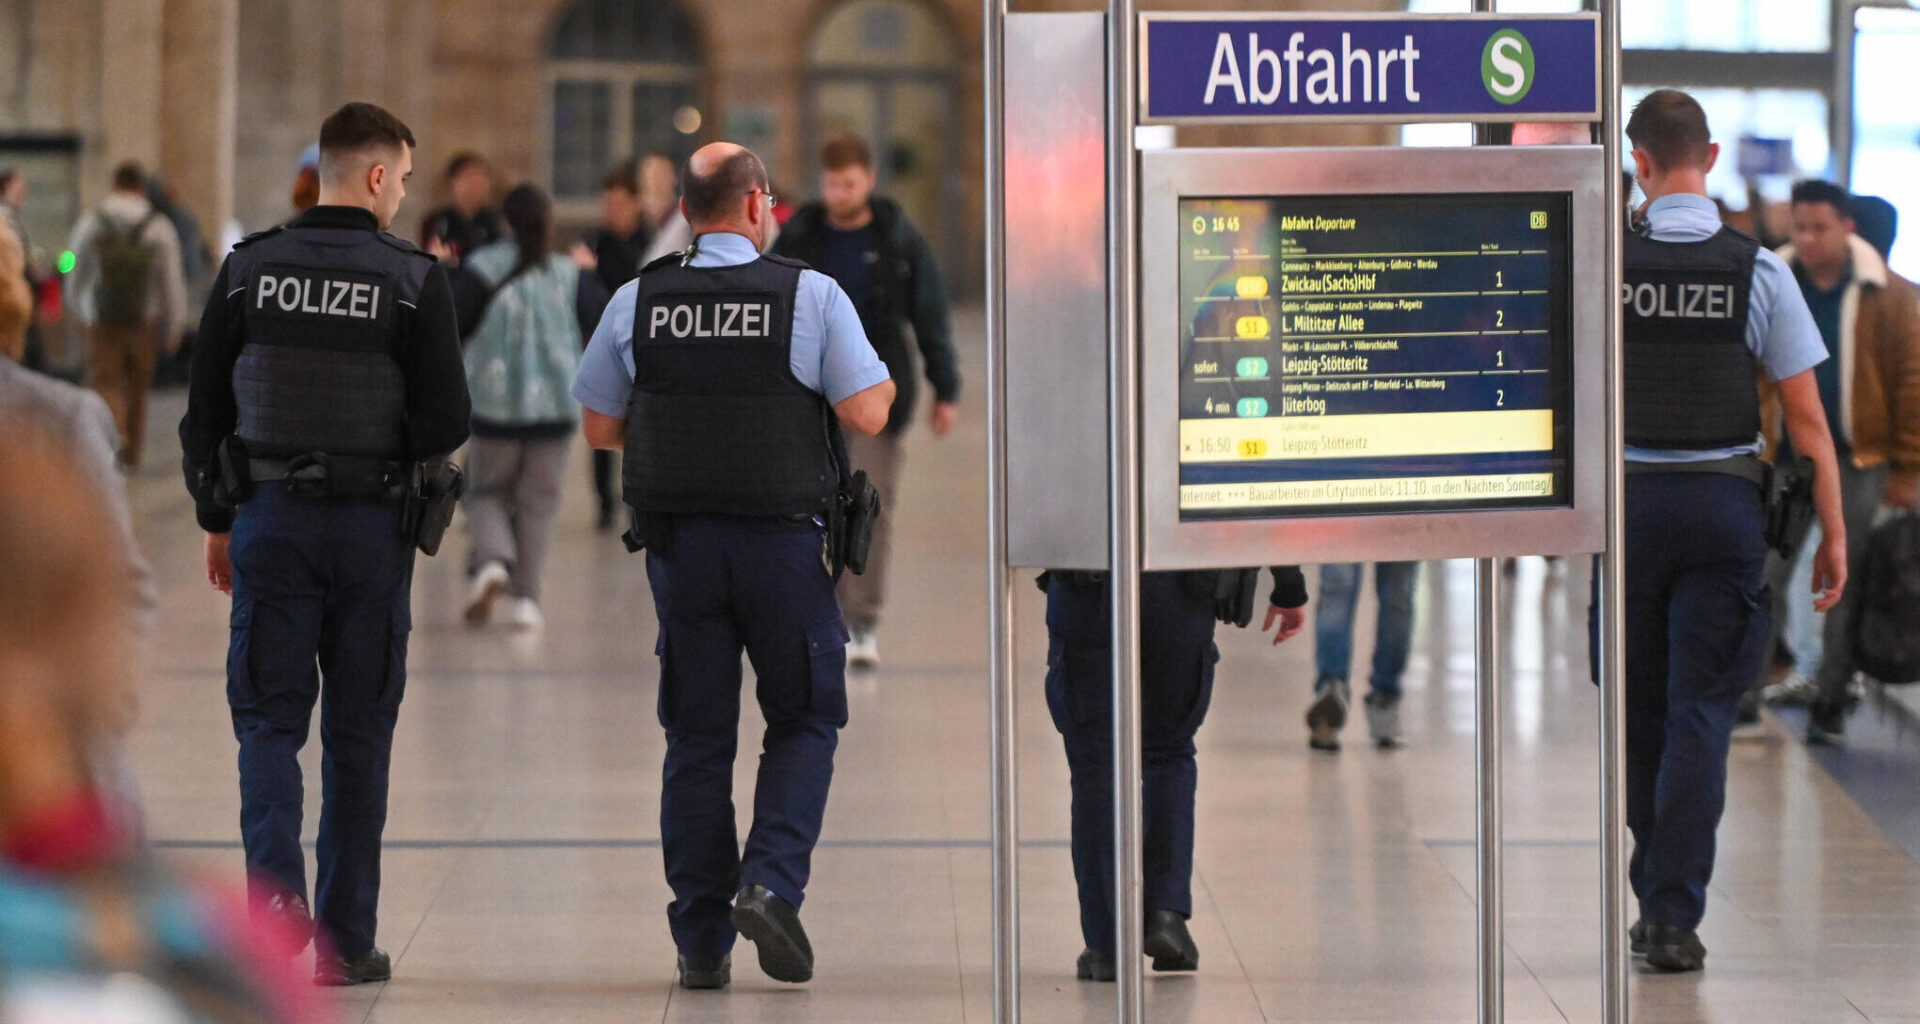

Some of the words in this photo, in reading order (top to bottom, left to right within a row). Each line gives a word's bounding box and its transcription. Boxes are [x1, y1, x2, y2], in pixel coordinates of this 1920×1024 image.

[1204, 32, 1420, 105] Abfahrt
[1491, 37, 1525, 96] S
[1281, 215, 1314, 231] Abfahrt
[1315, 214, 1356, 233] Departure
[1282, 260, 1310, 272] Connewitz
[1315, 260, 1353, 273] Markkleeberg
[1358, 259, 1386, 272] Altenburg
[1390, 258, 1411, 270] Gößnitz
[1417, 258, 1438, 269] Werdau
[1496, 270, 1503, 288] 1
[257, 275, 380, 319] POLIZEI
[1282, 301, 1300, 312] Gohlis
[1305, 301, 1334, 314] Coppiplatz
[1340, 301, 1364, 311] Leutzsch
[1369, 300, 1394, 311] Lindenau
[1399, 299, 1423, 312] Plagwitz
[650, 303, 770, 338] POLIZEI
[1282, 315, 1292, 333] L.
[1294, 314, 1337, 332] Miltitzer
[1339, 313, 1365, 332] Allee
[1496, 309, 1504, 328] 2
[1246, 320, 1258, 335] S1
[1282, 341, 1299, 352] Markt
[1341, 340, 1349, 351] Pl.
[1194, 359, 1218, 375] sofort
[1246, 359, 1259, 375] S2
[1283, 354, 1368, 376] Leipzig-Stötteritz
[1496, 350, 1503, 367] 1
[1283, 382, 1302, 395] Leipzig
[1302, 381, 1320, 392] Messe
[1326, 380, 1351, 392] Delitzsch
[1374, 379, 1400, 391] Bitterfeld
[1415, 378, 1446, 392] Wittenberg
[1205, 397, 1213, 414] 4
[1215, 402, 1231, 414] min
[1282, 395, 1326, 416] Jüterbog
[1496, 389, 1504, 407] 2
[1246, 400, 1259, 416] S2
[1246, 441, 1258, 456] S1
[1249, 486, 1310, 502] Bauarbeiten
[1312, 486, 1324, 499] im
[1326, 482, 1377, 504] Citytunnel
[1380, 481, 1394, 497] bis
[1397, 478, 1430, 497] 11.10.
[1432, 481, 1442, 495] in
[1443, 479, 1461, 494] den
[1464, 478, 1505, 494] Nächten
